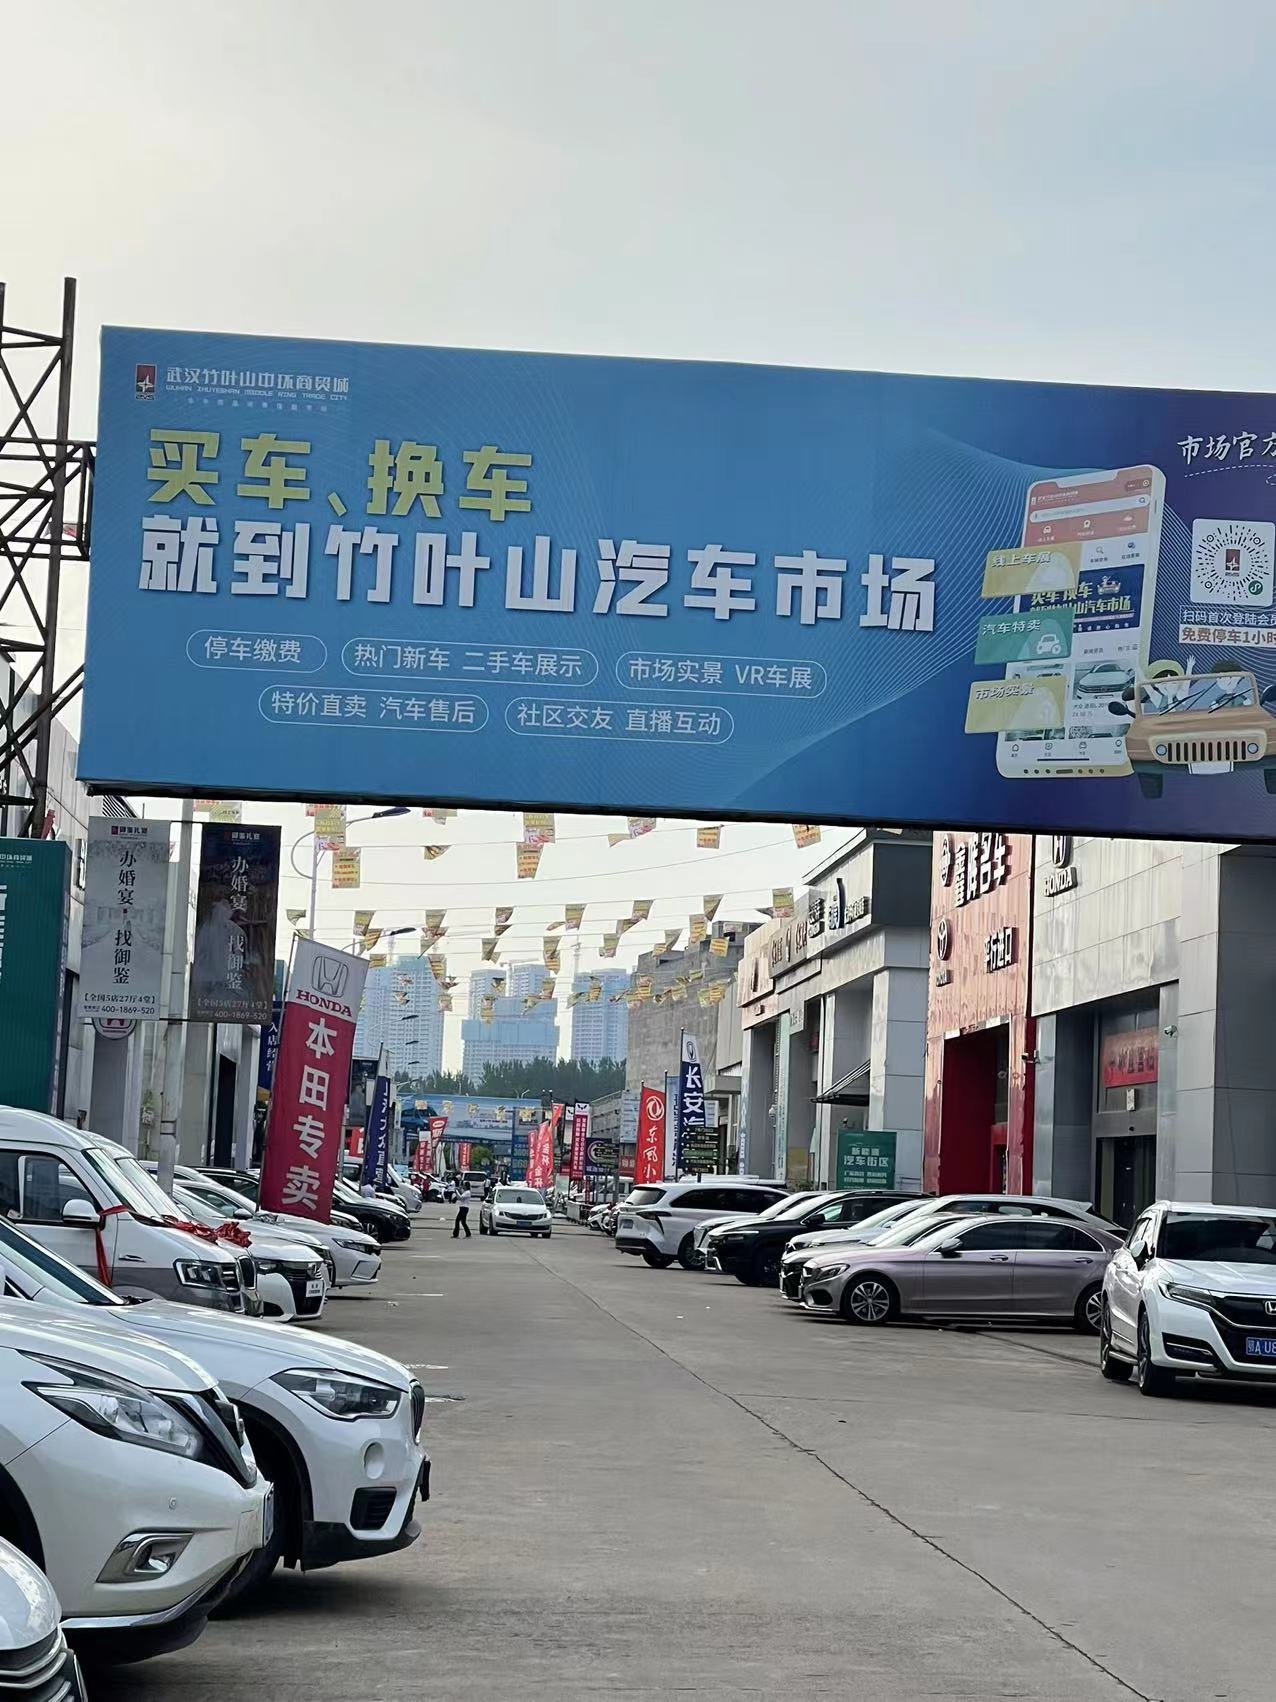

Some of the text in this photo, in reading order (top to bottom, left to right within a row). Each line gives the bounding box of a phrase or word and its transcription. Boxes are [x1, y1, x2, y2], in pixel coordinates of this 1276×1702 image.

[166, 366, 349, 393] 武汉竹叶山中环商贸城
[147, 428, 533, 521] 买车、换车
[138, 514, 936, 632] 就到竹叶山汽车市场
[982, 619, 1041, 636] 汽车特卖
[203, 635, 302, 664] 停车缴费
[353, 643, 583, 678] 热门新车 二手车展示
[629, 657, 813, 690] 市场实景 VR车展
[271, 691, 476, 724] 特价直卖 汽车售后
[516, 702, 722, 736] 社区交友 直播互动
[1044, 868, 1073, 896] HONDA
[101, 1006, 155, 1015] 400-1869-520
[296, 989, 353, 1018] HONDA
[282, 1017, 338, 1210] 本田专卖
[643, 1125, 659, 1184] 东风小
